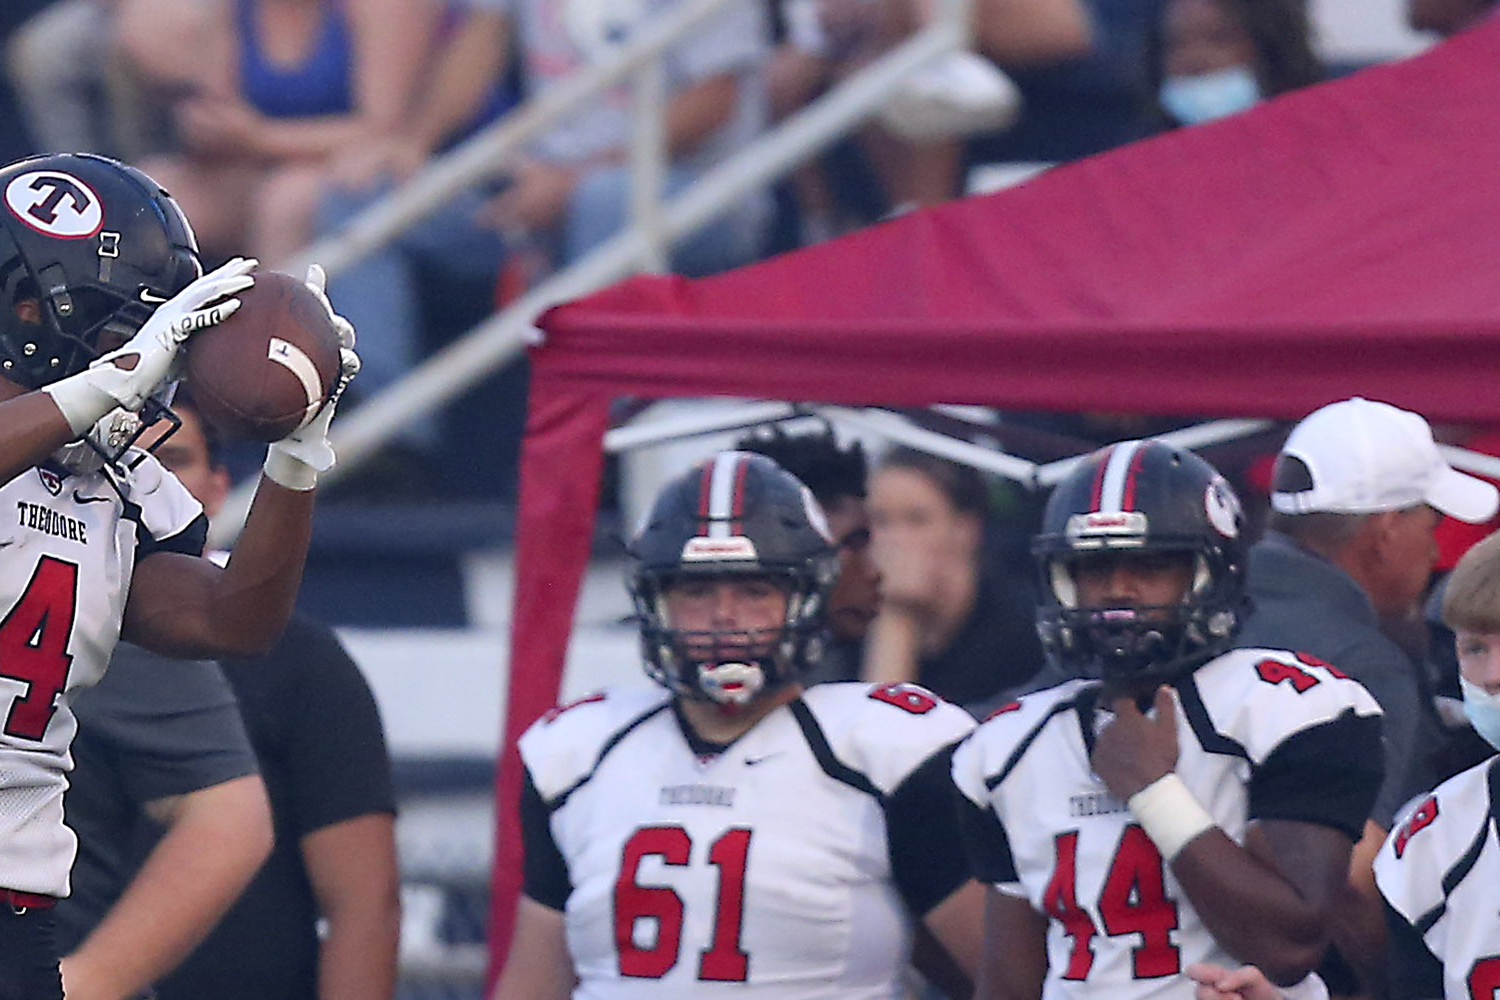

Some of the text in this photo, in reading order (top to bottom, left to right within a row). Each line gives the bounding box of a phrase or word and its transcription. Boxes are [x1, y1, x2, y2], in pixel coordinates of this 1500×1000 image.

[27, 176, 91, 225] T
[17, 501, 87, 544] THEODORE
[614, 825, 752, 981] 61
[1043, 823, 1180, 981] 44
